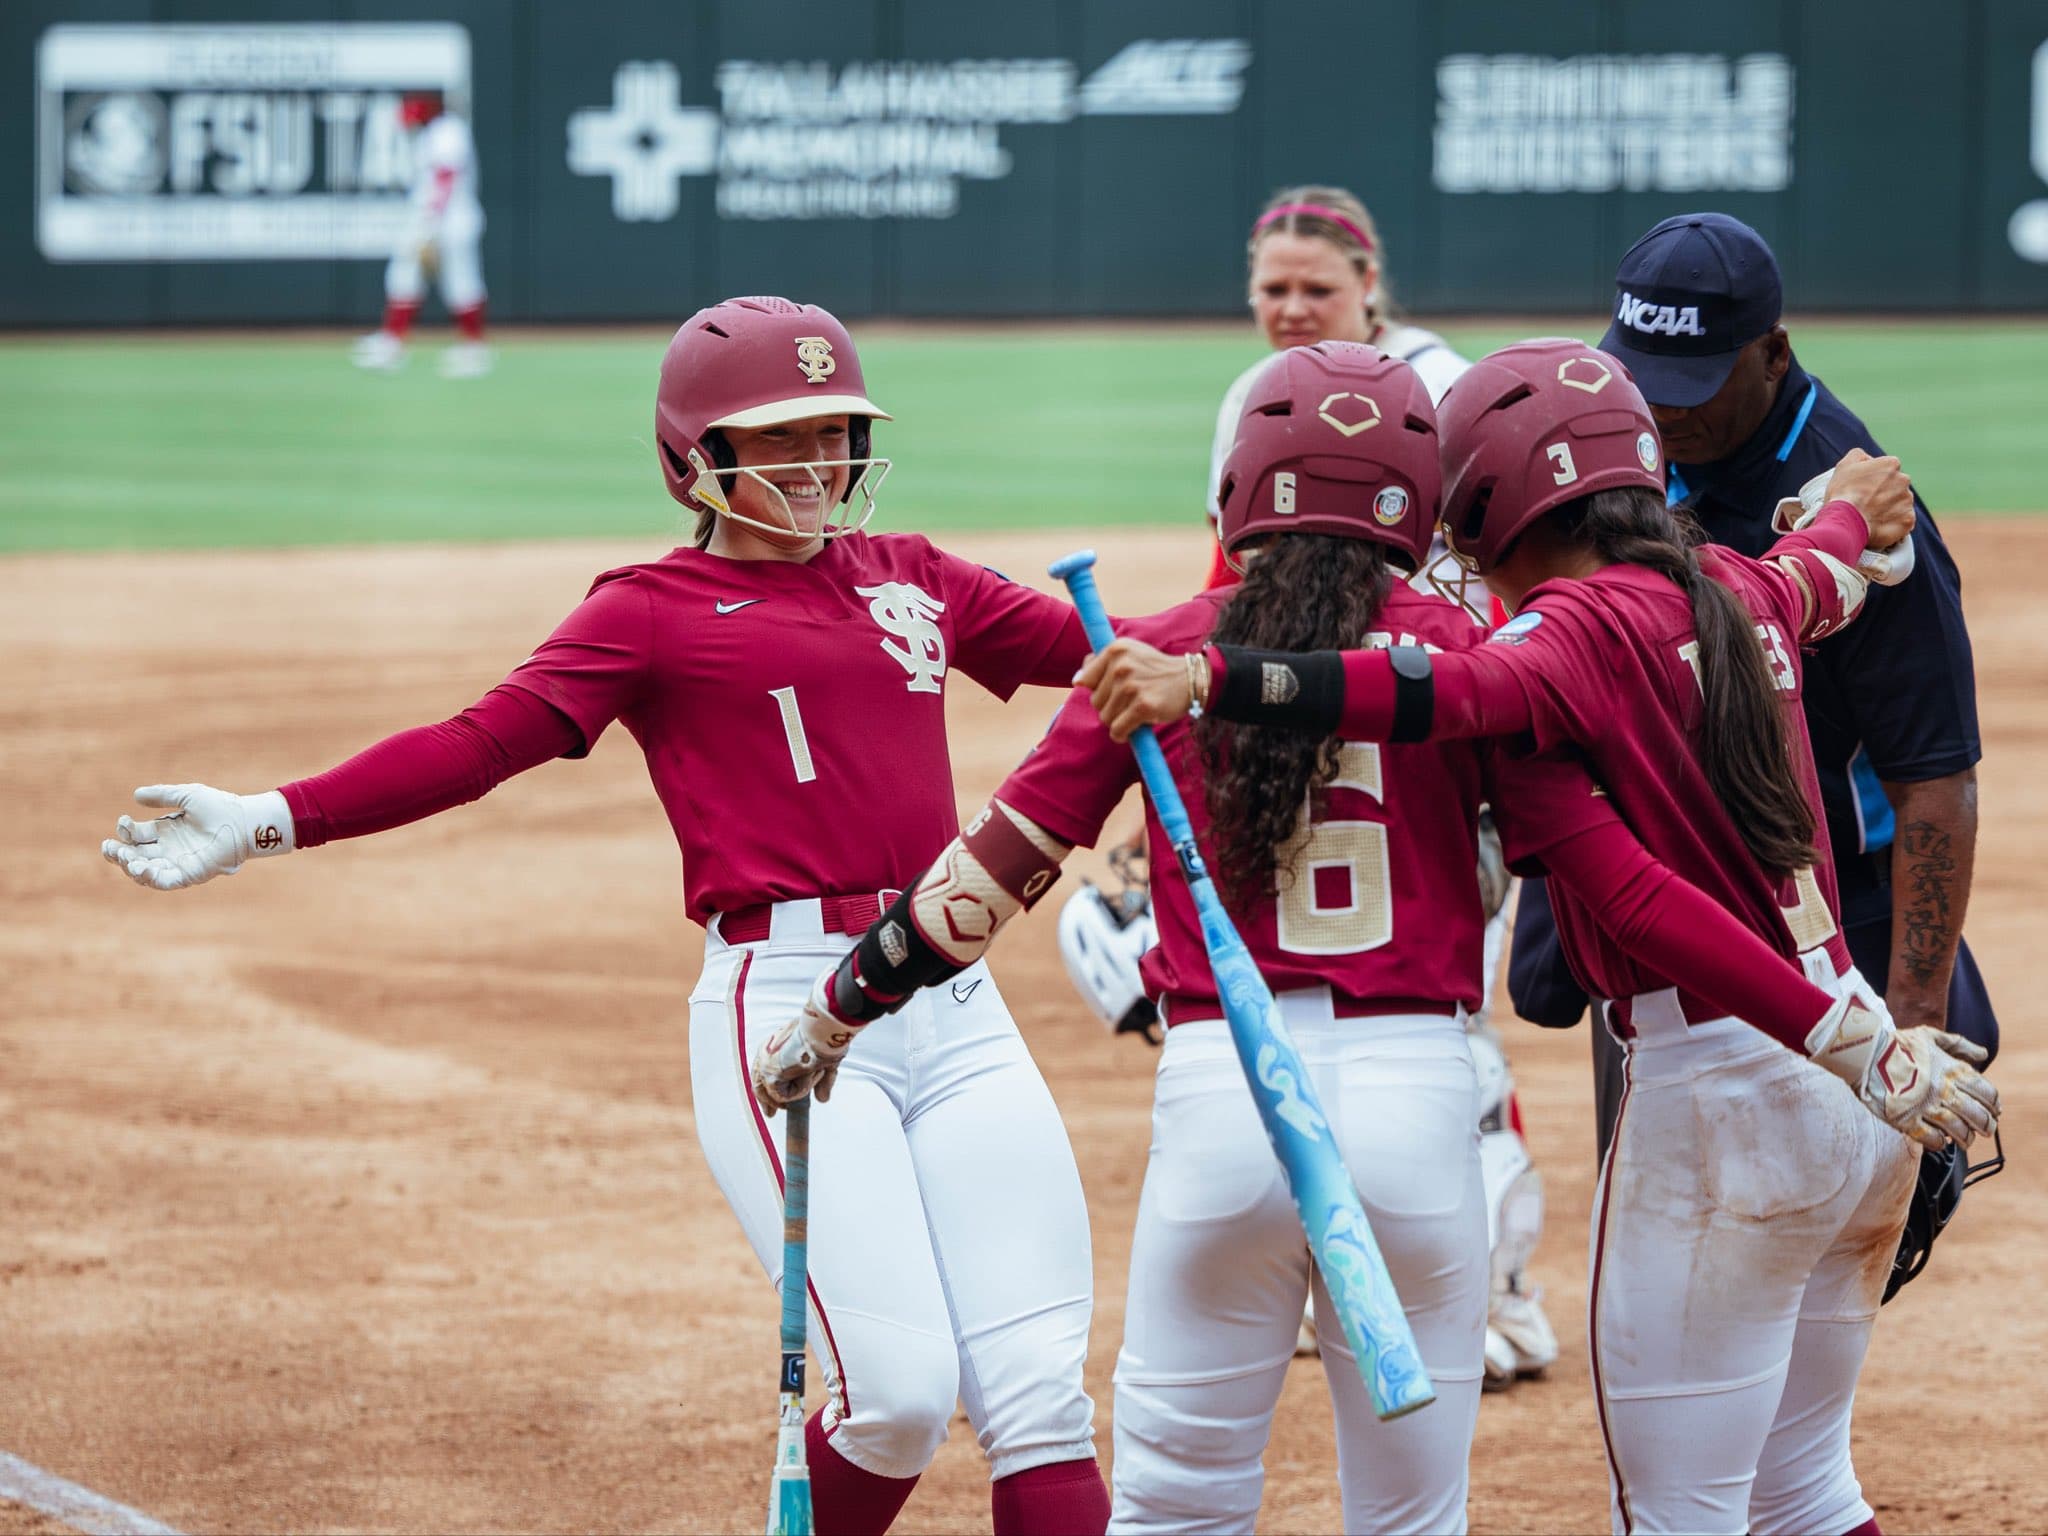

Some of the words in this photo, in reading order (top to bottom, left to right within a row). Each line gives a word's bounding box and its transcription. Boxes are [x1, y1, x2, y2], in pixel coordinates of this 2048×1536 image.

[170, 94, 313, 193] FSU
[1618, 292, 1698, 336] NCAA
[1274, 472, 1296, 514] 6
[1546, 442, 1578, 486] 3
[768, 686, 817, 784] 1
[1275, 741, 1394, 956] 6
